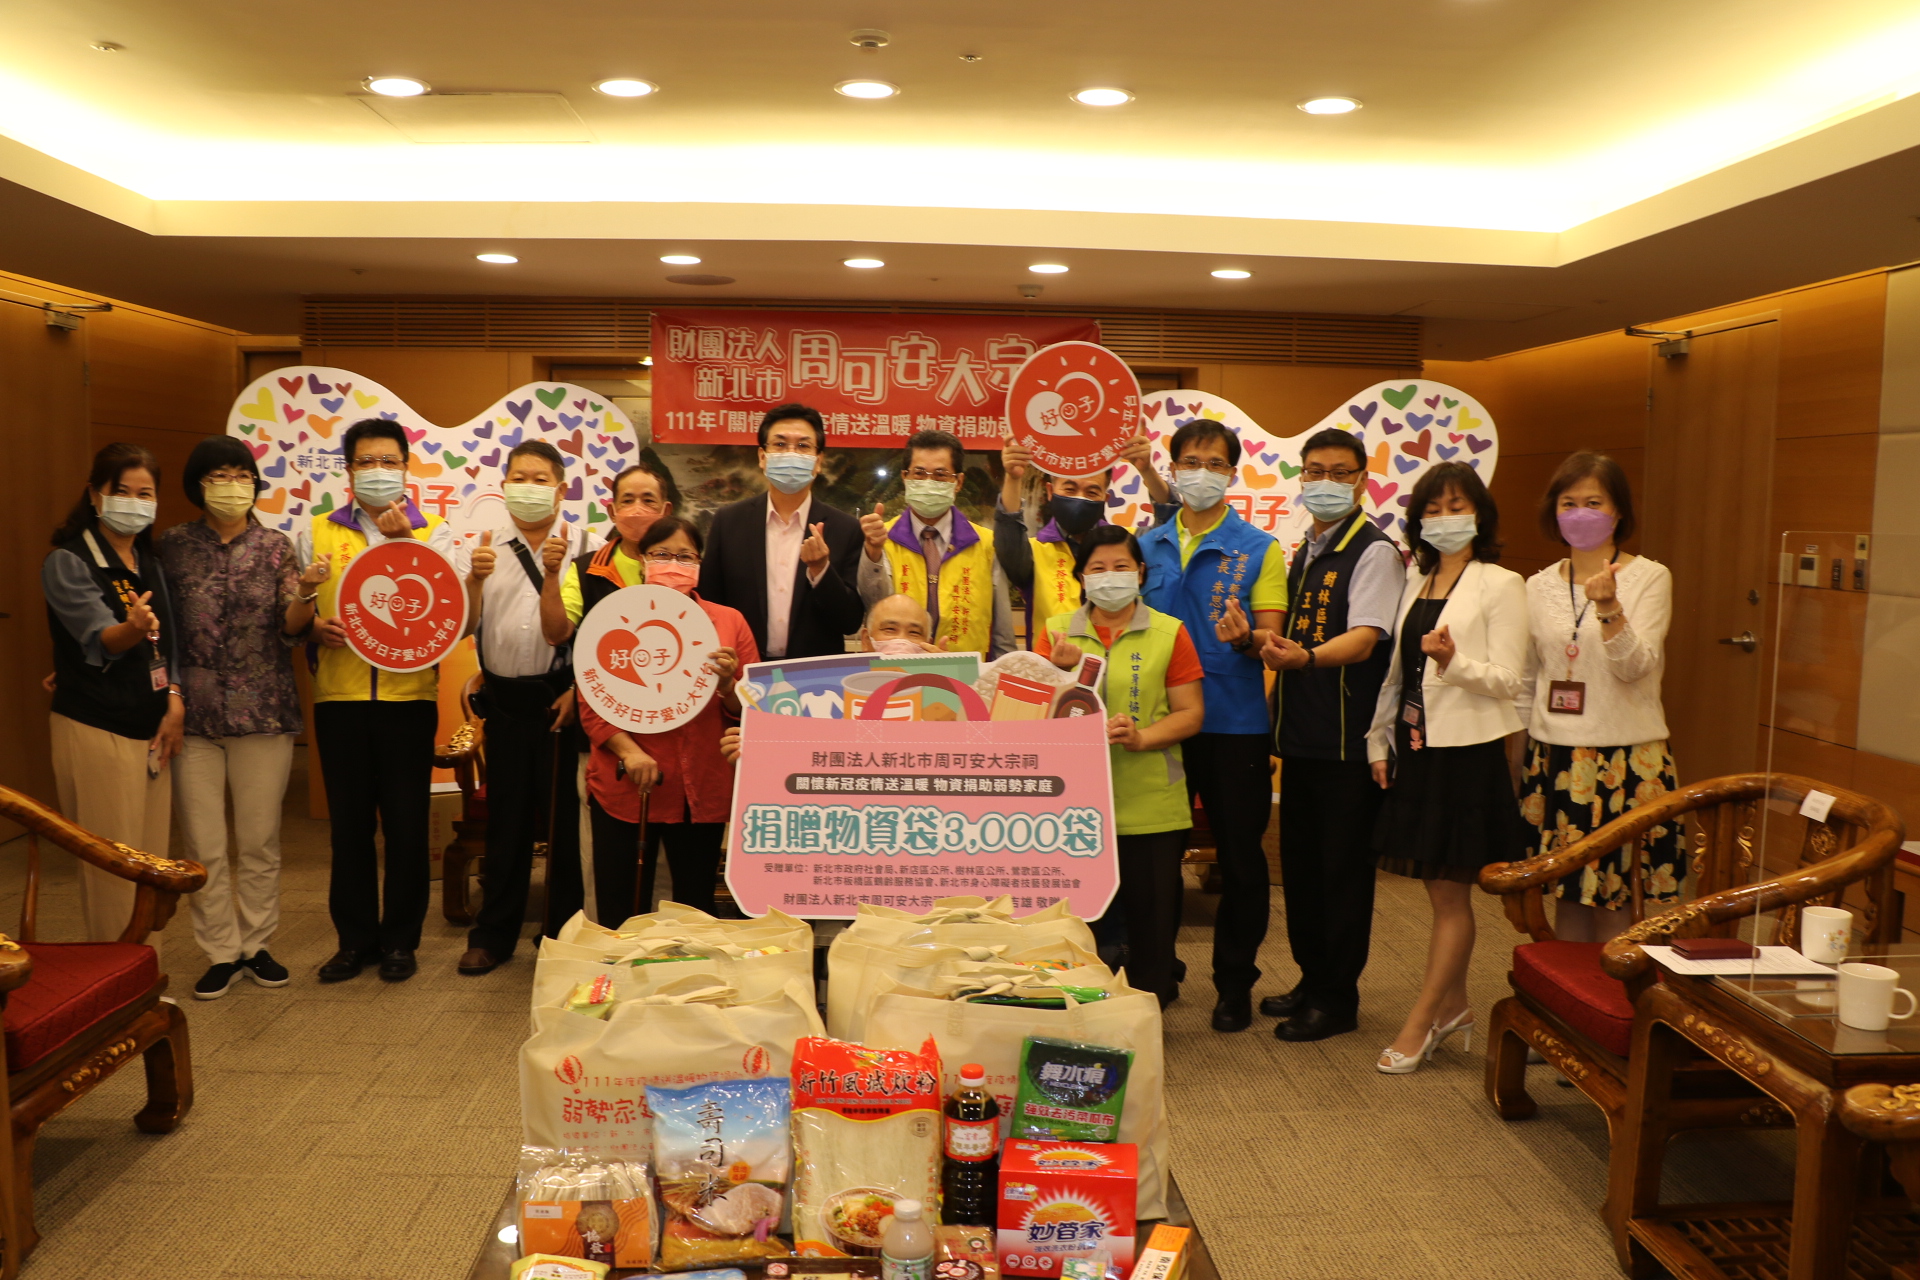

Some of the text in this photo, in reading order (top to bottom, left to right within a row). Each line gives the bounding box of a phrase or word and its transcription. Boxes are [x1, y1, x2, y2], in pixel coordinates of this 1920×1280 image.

[668, 328, 785, 363] 財團法人
[697, 366, 784, 400] 新北市
[1021, 394, 1138, 470] 新北市好日子愛心大平台
[1313, 571, 1338, 642] 樹林區長
[343, 602, 457, 661] 新北市好日子愛心大平台
[582, 661, 714, 724] 新北市好日子愛心大平台
[811, 751, 1039, 770] 財團法人新北市周可安大宗祠
[795, 776, 1053, 793] 關懷新冠疫情送溫暖 物資捐助弱勢家庭
[747, 808, 1098, 853] 捐贈物資袋3,000袋
[799, 1069, 937, 1096] 新竹風城炊粉
[1028, 1220, 1106, 1242] 妙管家
